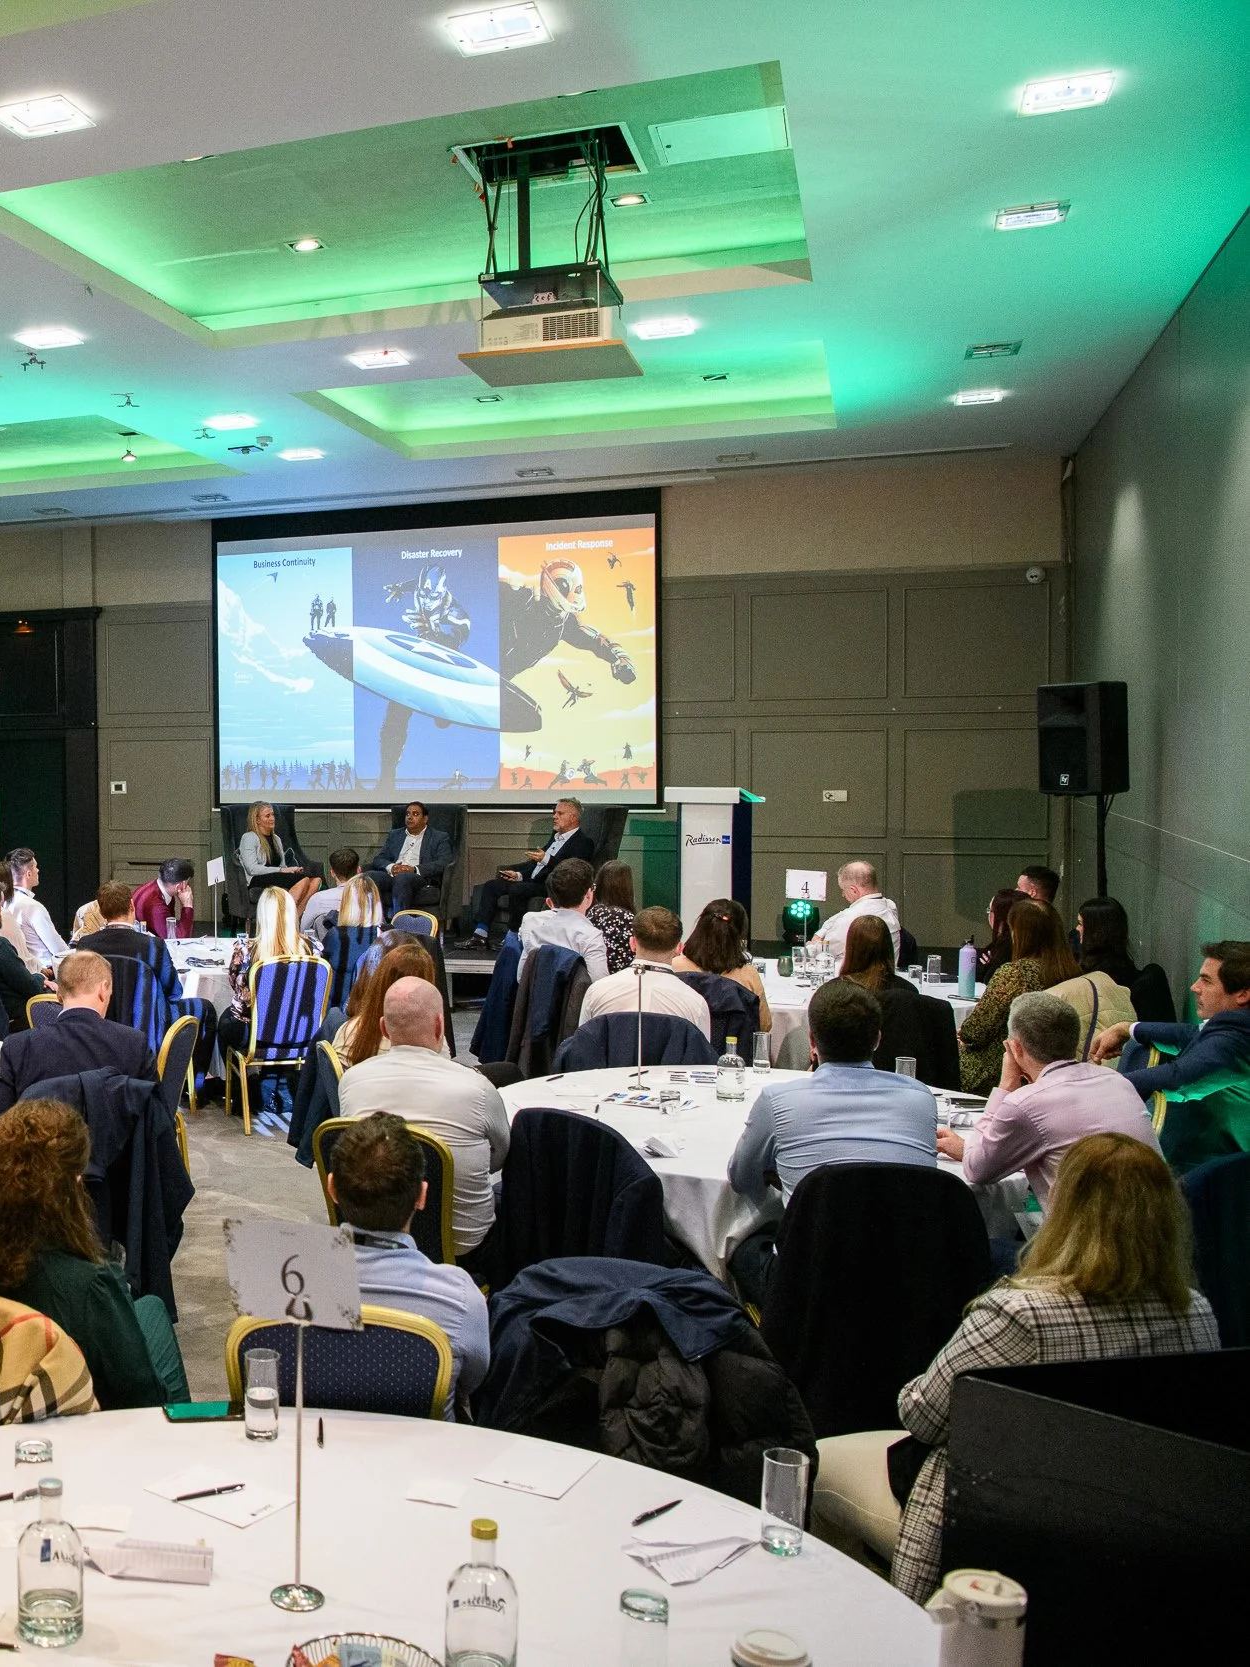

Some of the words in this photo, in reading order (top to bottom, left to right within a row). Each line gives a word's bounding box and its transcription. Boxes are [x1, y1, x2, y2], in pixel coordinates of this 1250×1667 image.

[545, 540, 576, 551] Incident
[577, 539, 614, 550] Response
[401, 550, 430, 560] Disaster
[430, 549, 463, 559] Recovery
[253, 559, 281, 569] Business
[282, 557, 316, 567] Continuity
[801, 881, 810, 894] 4
[280, 1254, 305, 1295] 6
